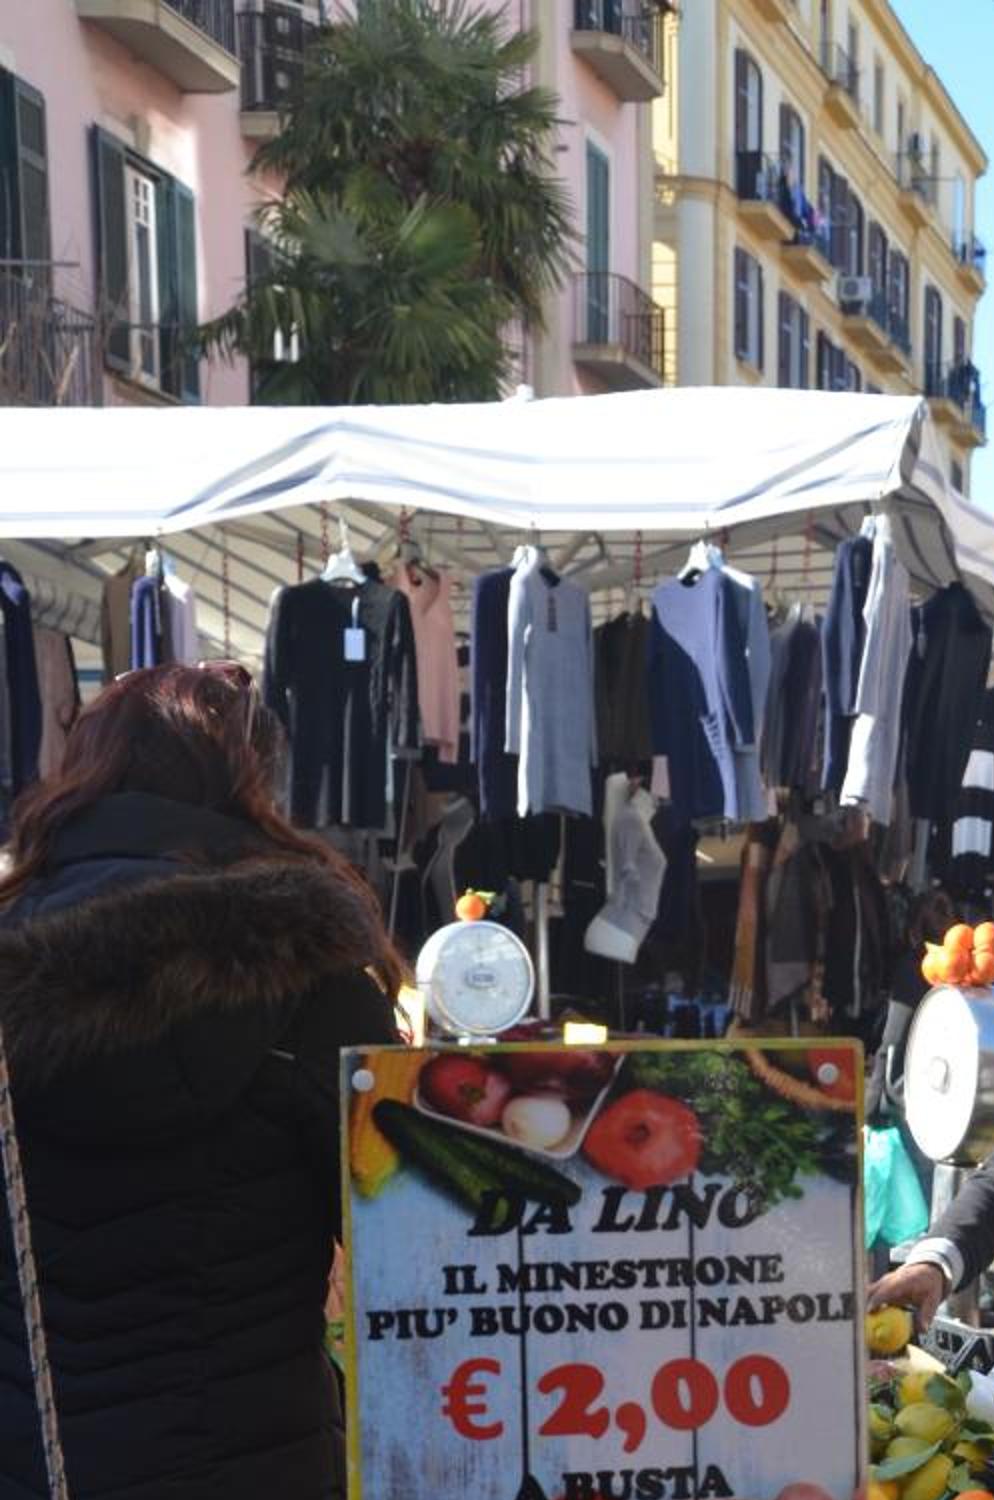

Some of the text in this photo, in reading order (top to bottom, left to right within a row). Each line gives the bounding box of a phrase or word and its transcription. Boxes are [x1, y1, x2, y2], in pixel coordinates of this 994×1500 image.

[467, 1182, 766, 1237] DA LINO
[443, 1254, 784, 1295] IL MINESTRONE
[470, 1299, 628, 1337] BUONO
[640, 1299, 687, 1330] DI
[697, 1291, 857, 1328] NAPOLI
[441, 1354, 791, 1454] € 2,00
